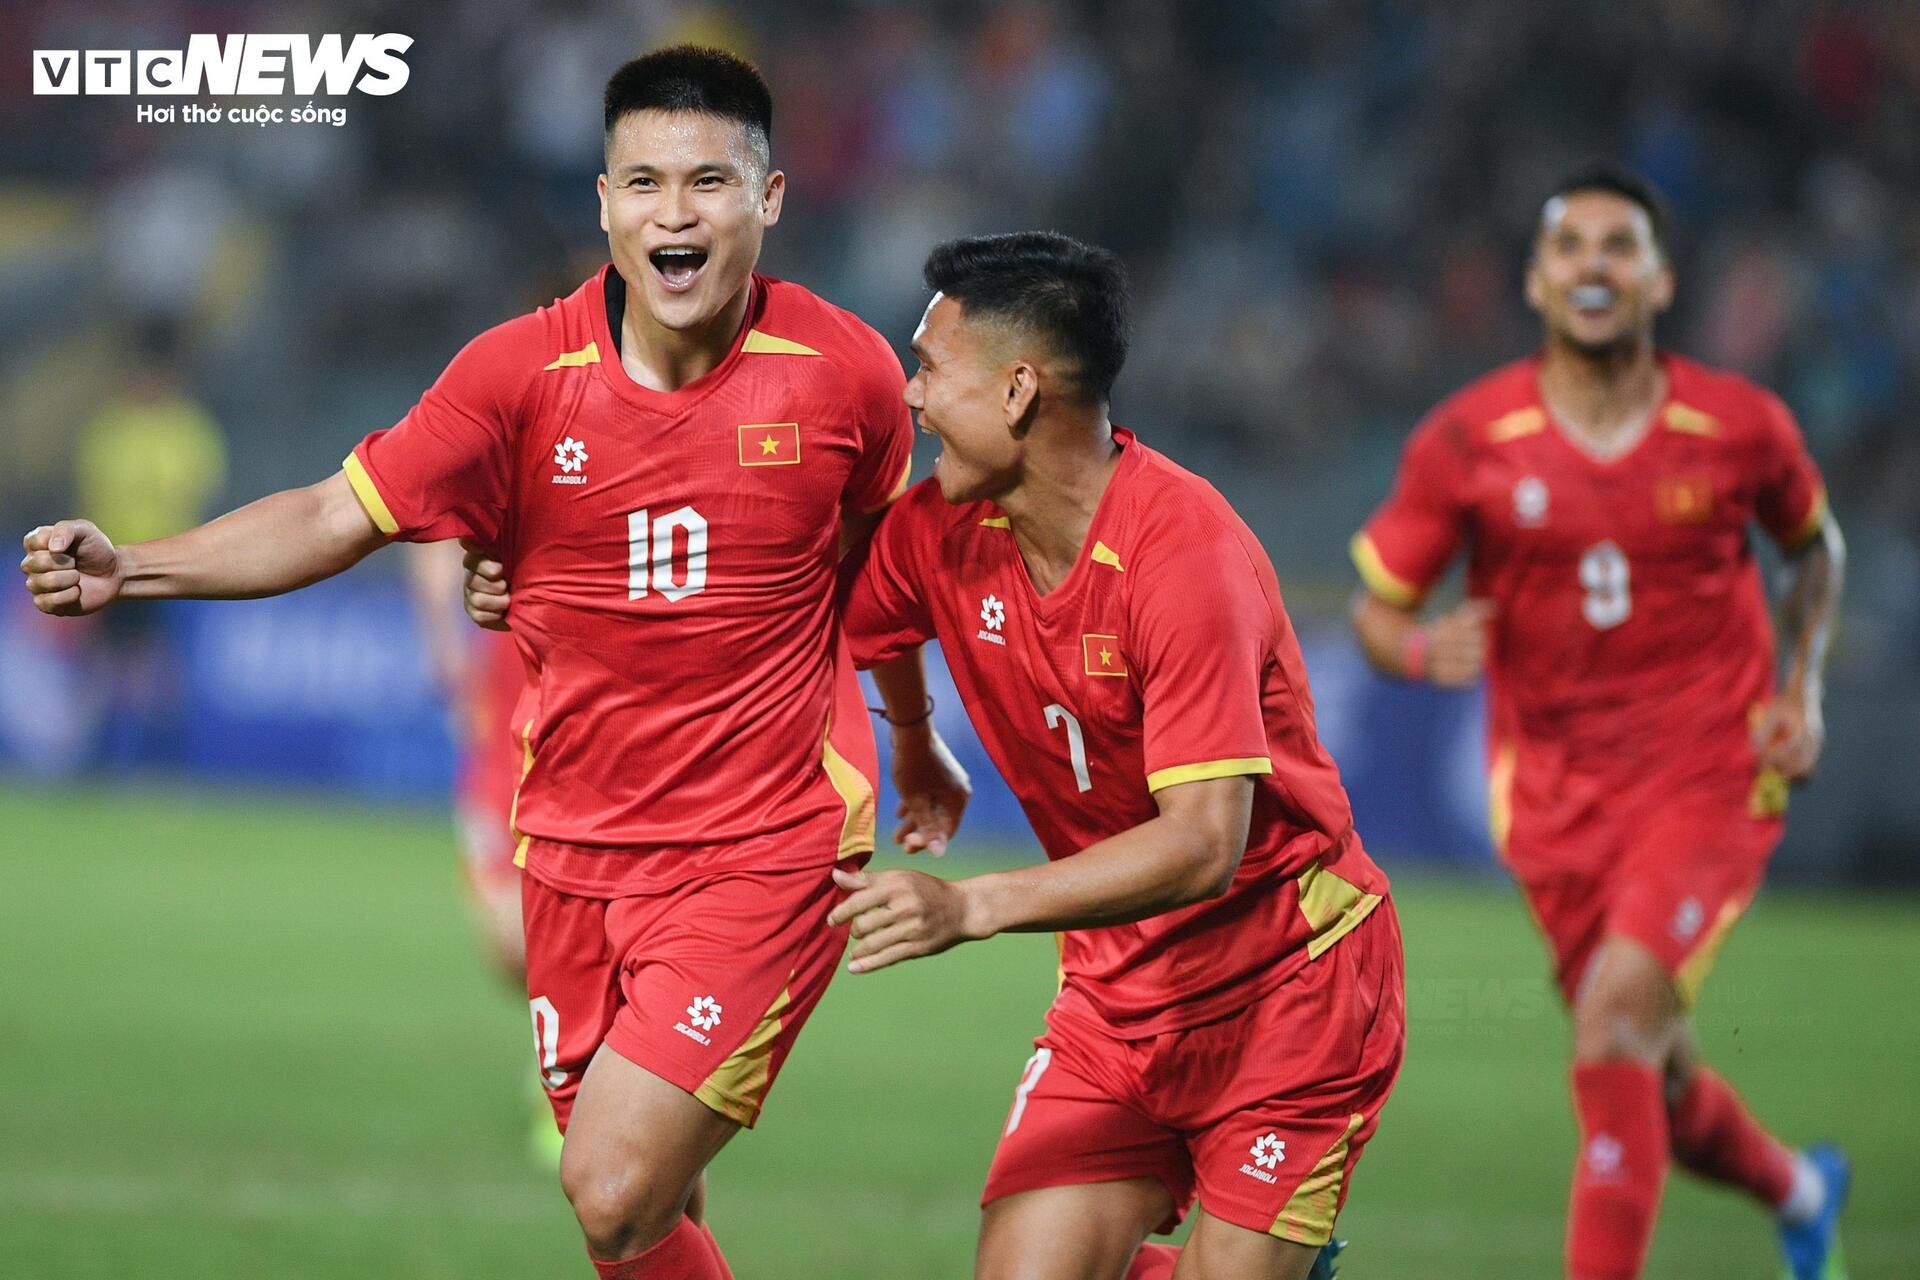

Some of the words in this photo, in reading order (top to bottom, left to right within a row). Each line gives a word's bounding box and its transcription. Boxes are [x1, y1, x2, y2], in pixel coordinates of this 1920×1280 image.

[628, 505, 709, 603] 10
[1578, 538, 1633, 631] 9
[1043, 703, 1093, 793] 7
[1004, 1047, 1052, 1138] 7
[1238, 1163, 1278, 1185] JOGARBOLA
